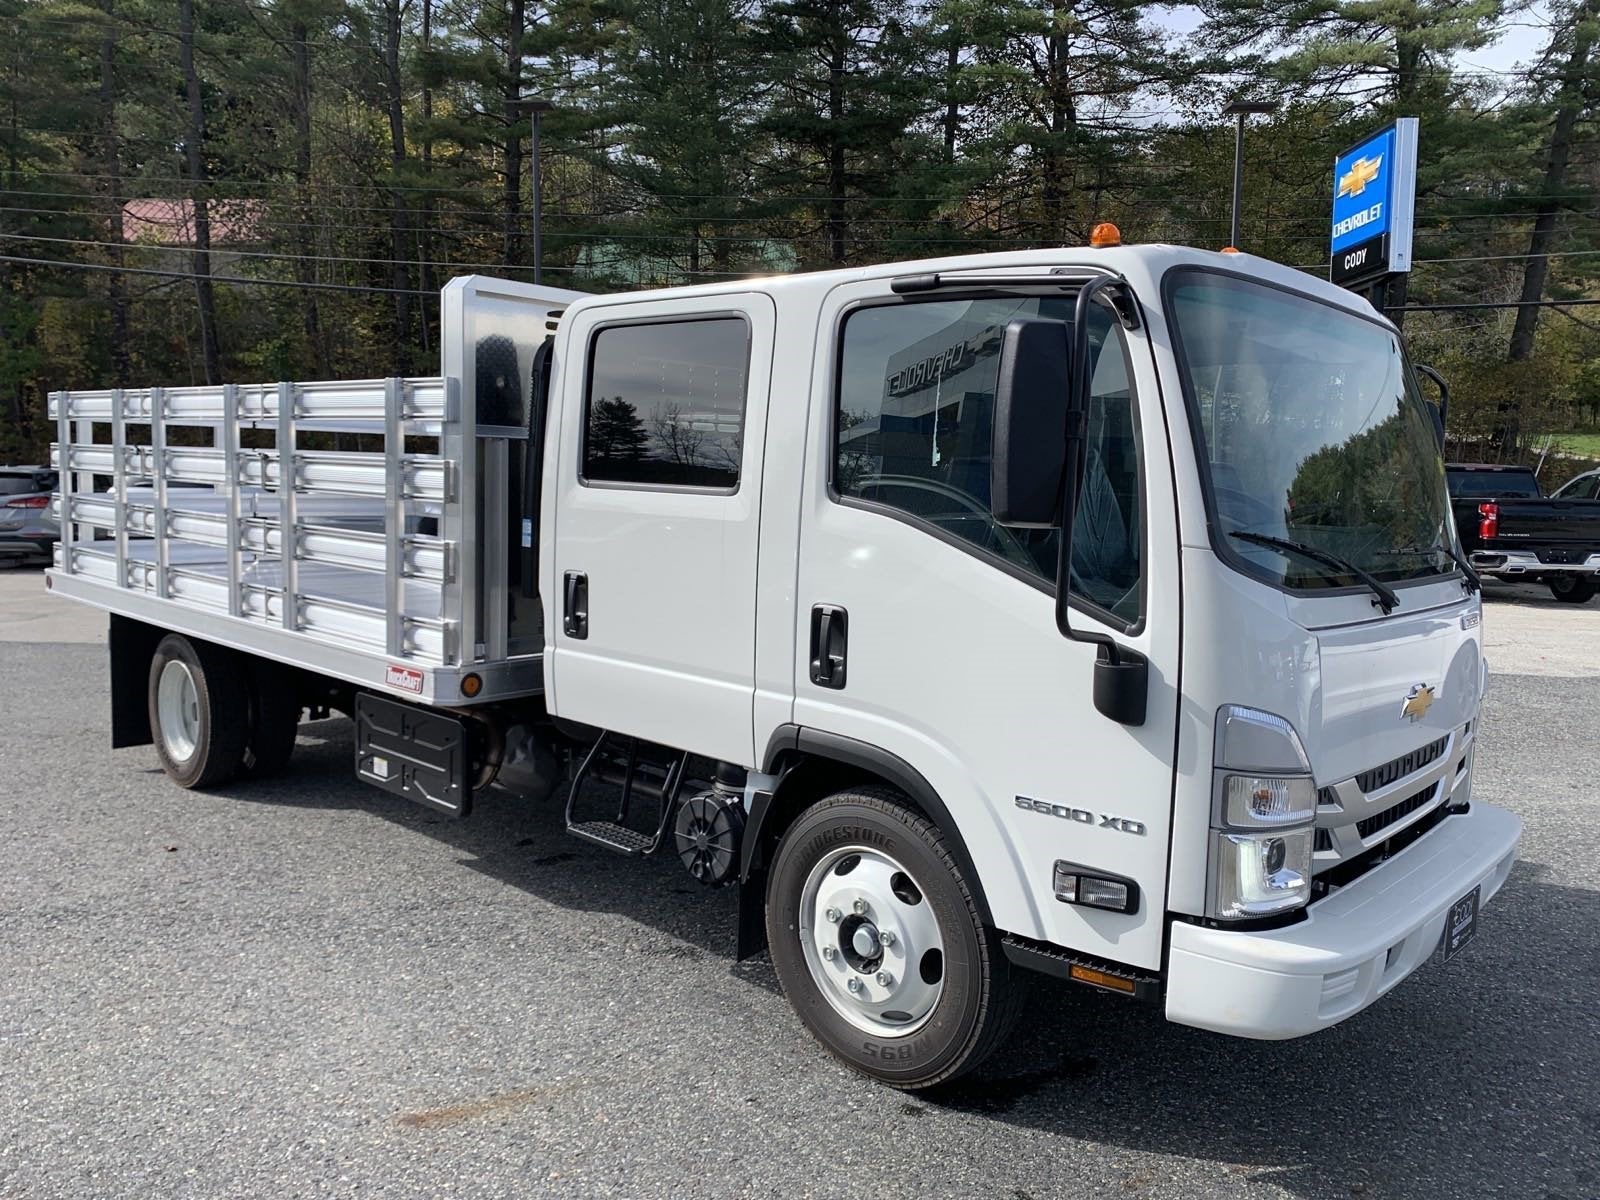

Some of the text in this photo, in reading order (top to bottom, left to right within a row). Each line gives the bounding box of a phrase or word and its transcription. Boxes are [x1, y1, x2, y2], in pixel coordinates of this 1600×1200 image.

[1333, 202, 1383, 239] CHEVROLET
[1344, 248, 1368, 271] CODY
[1014, 794, 1147, 837] 5500 XD
